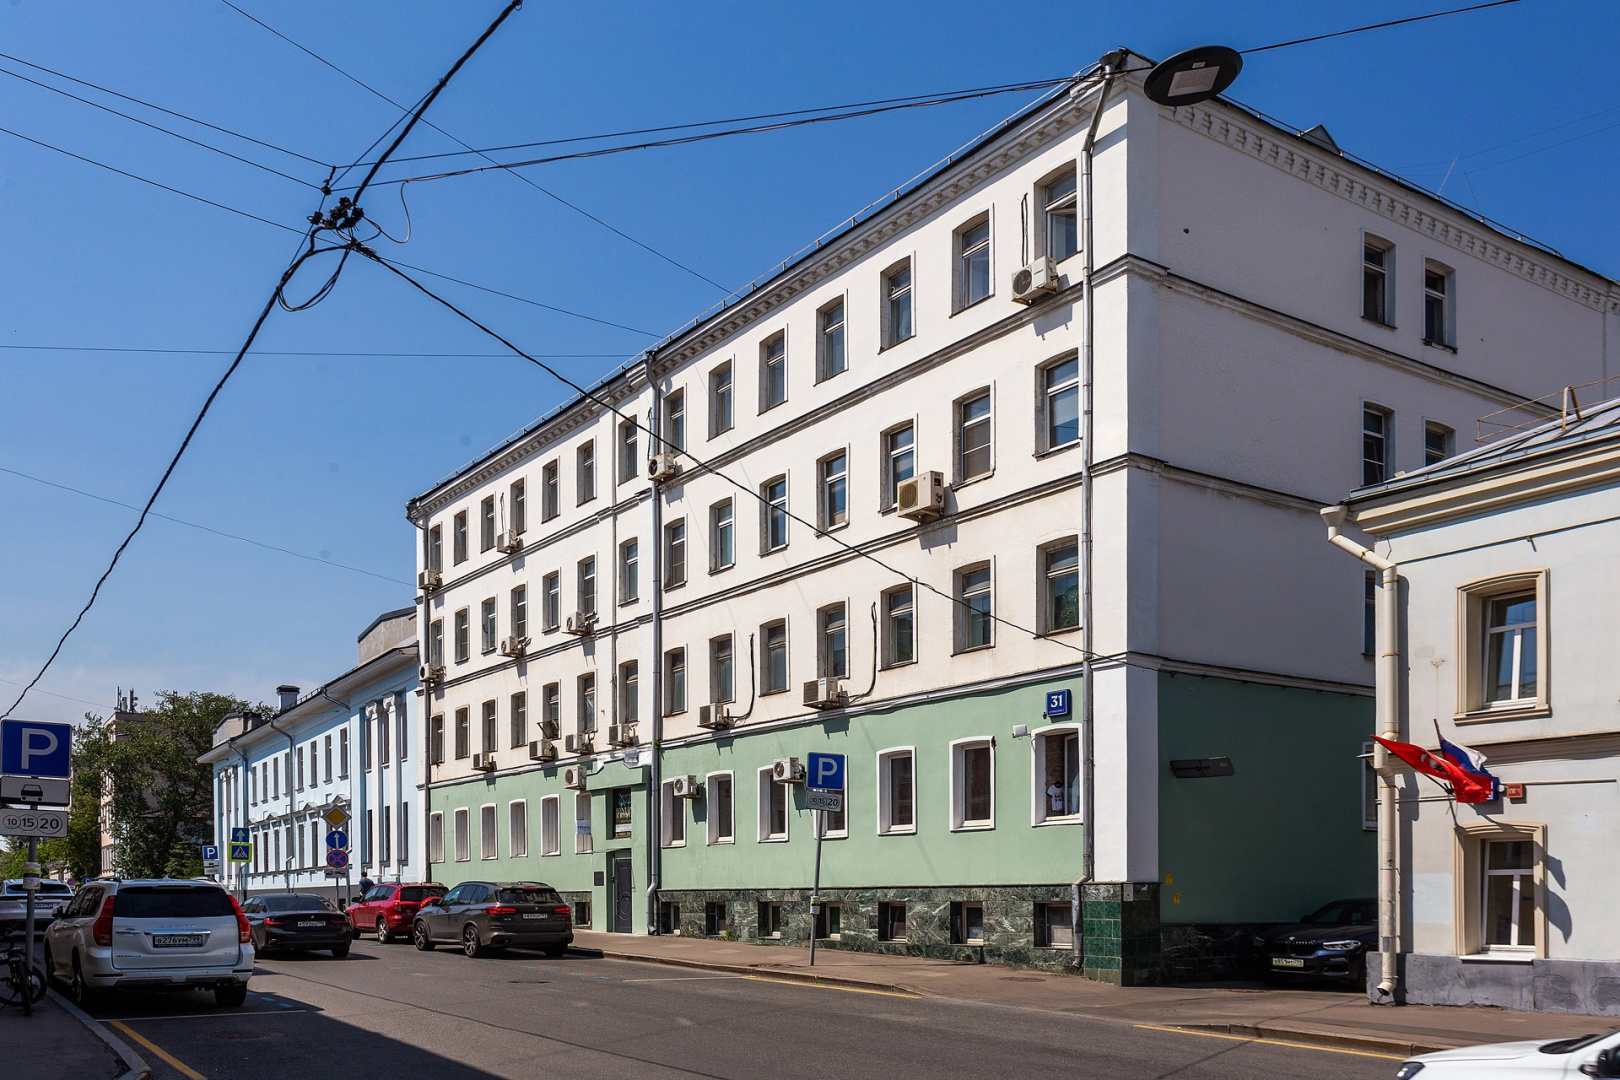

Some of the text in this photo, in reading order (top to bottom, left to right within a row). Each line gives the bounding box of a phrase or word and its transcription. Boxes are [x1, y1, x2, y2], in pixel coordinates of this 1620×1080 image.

[1051, 694, 1063, 708] 31
[21, 728, 58, 770] P
[817, 757, 838, 785] P
[818, 797, 826, 805] 15
[827, 798, 838, 807] 20
[7, 818, 60, 829] 10 15 20
[206, 847, 216, 859] P
